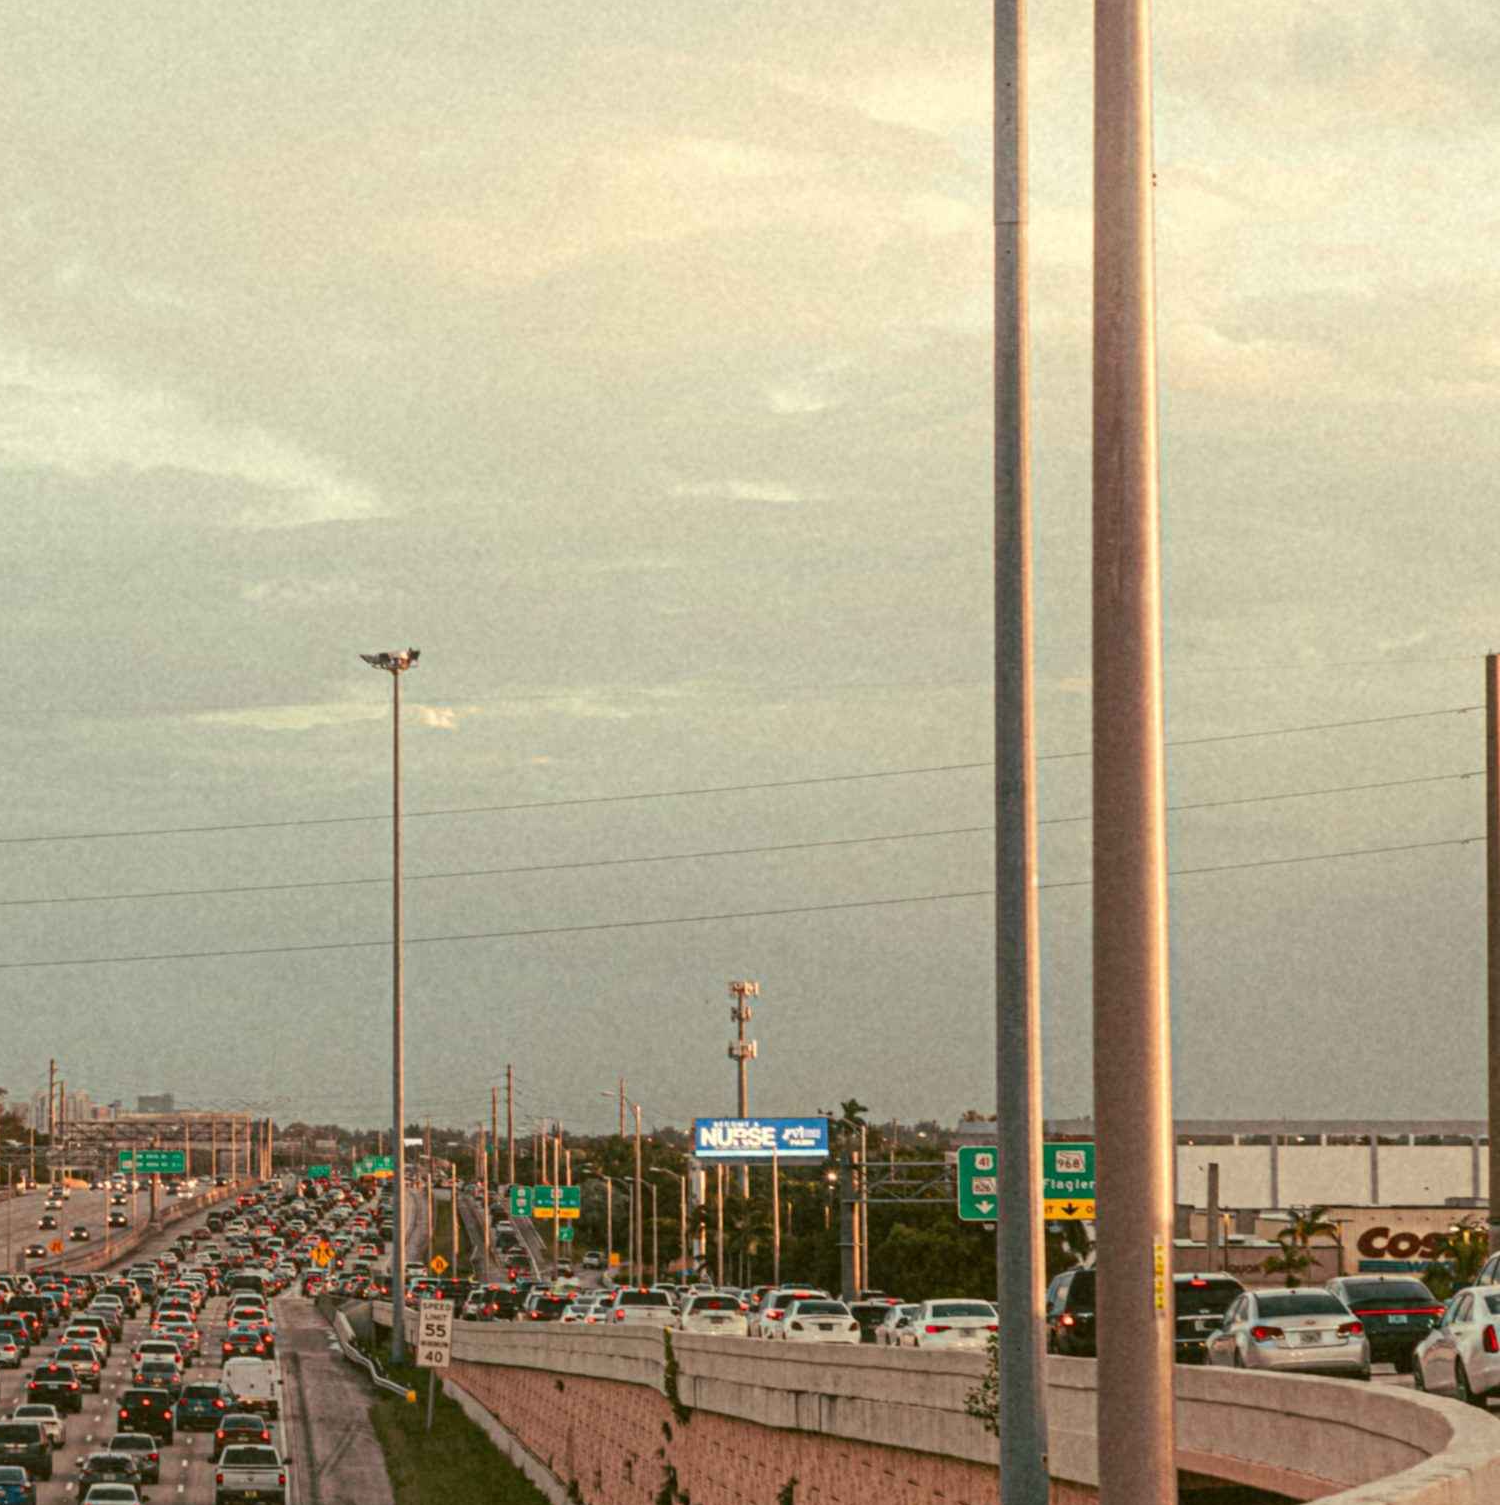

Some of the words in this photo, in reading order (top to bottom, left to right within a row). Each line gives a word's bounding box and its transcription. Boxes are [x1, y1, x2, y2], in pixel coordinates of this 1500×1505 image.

[700, 1127, 777, 1147] NURSE
[1043, 1178, 1096, 1192] Flagler
[425, 1323, 446, 1338] 55
[425, 1351, 443, 1364] 40
